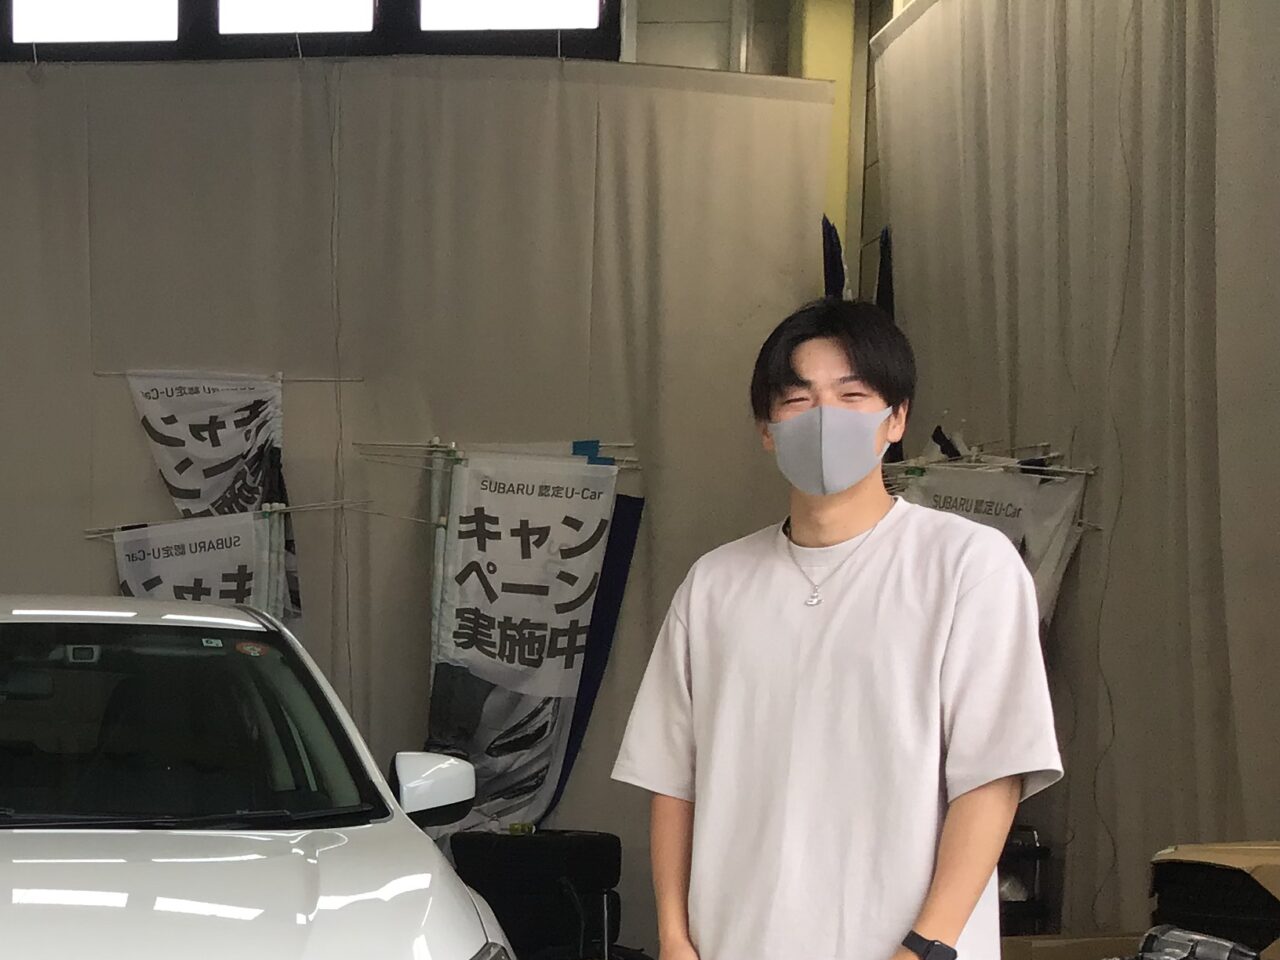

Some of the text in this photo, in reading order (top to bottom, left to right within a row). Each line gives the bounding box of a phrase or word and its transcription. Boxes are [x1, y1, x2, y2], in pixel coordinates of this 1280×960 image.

[480, 479, 536, 496] SUBARU
[458, 507, 609, 560] キャン
[455, 560, 600, 615] ペーン
[451, 607, 592, 670] 実施中
